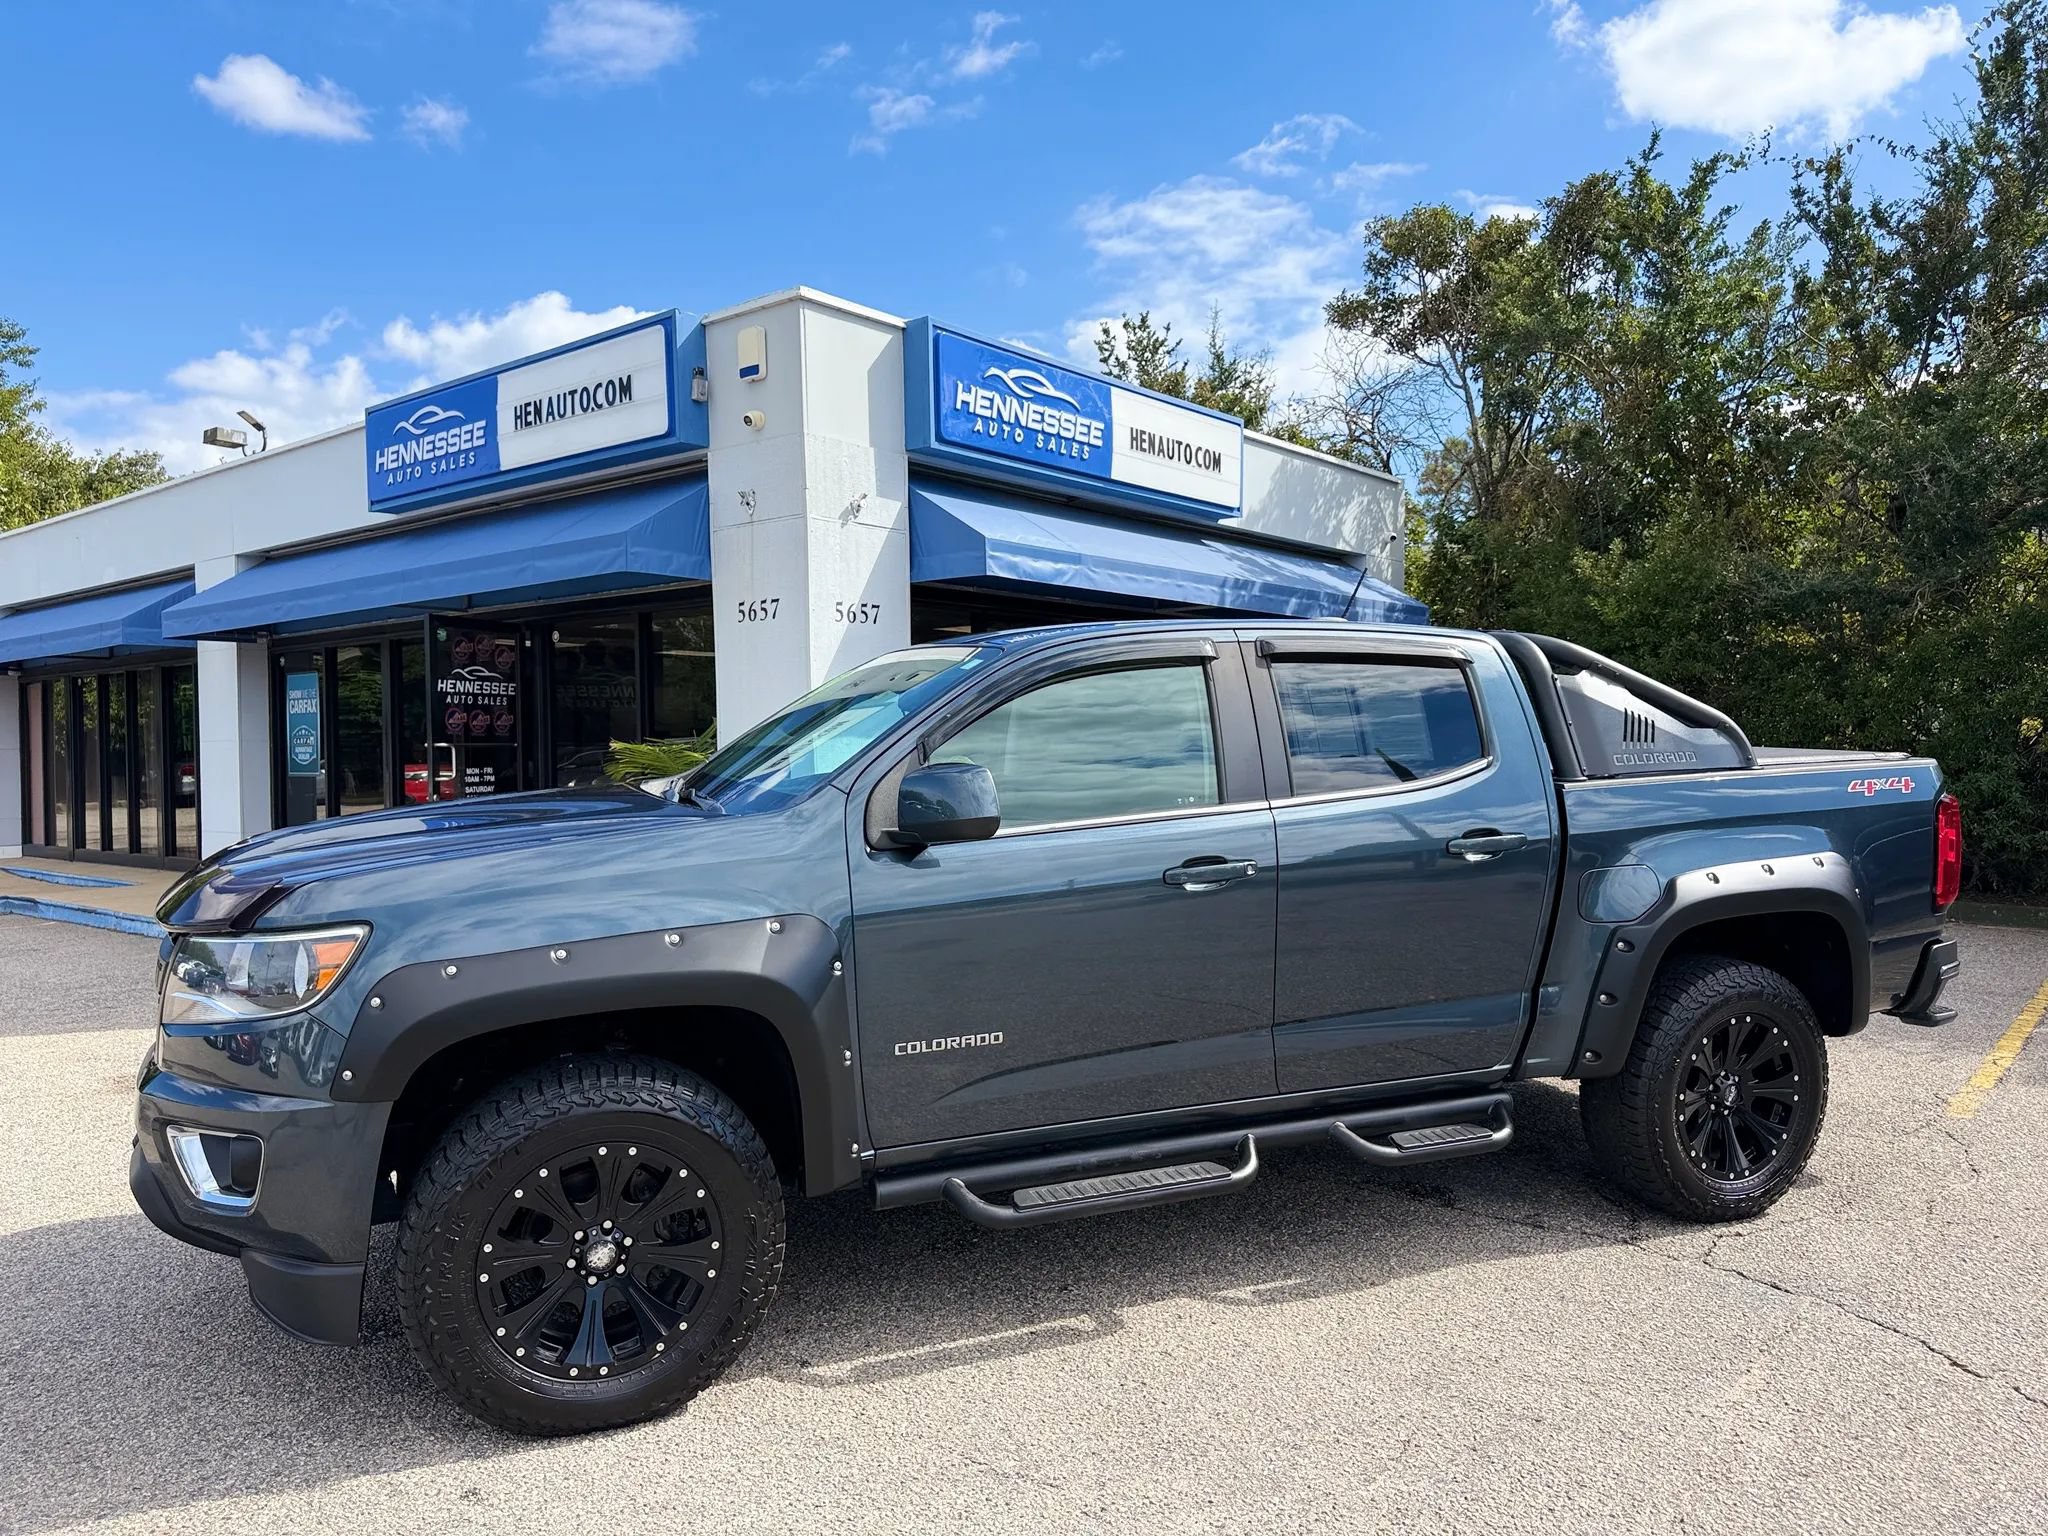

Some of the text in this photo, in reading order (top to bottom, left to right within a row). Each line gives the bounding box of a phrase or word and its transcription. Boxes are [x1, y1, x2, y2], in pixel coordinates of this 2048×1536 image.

[513, 374, 633, 432] HENAUTO.COM
[955, 380, 1105, 447] HENNESSEE
[375, 419, 487, 473] HENNESSEE
[973, 417, 1090, 460] AUTO SALES
[1130, 427, 1222, 474] HENAUTO.COM
[387, 452, 476, 487] AUTO SALES
[738, 598, 780, 623] 5657
[835, 601, 881, 625] 5657
[437, 679, 517, 695] HENNESSEE
[289, 699, 317, 714] CARFAX
[445, 694, 508, 706] AUTO SALES
[466, 767, 480, 775] MON
[1613, 751, 1697, 766] COLORADO
[465, 785, 495, 794] SATURDAY
[894, 1031, 1004, 1056] COLORADO
